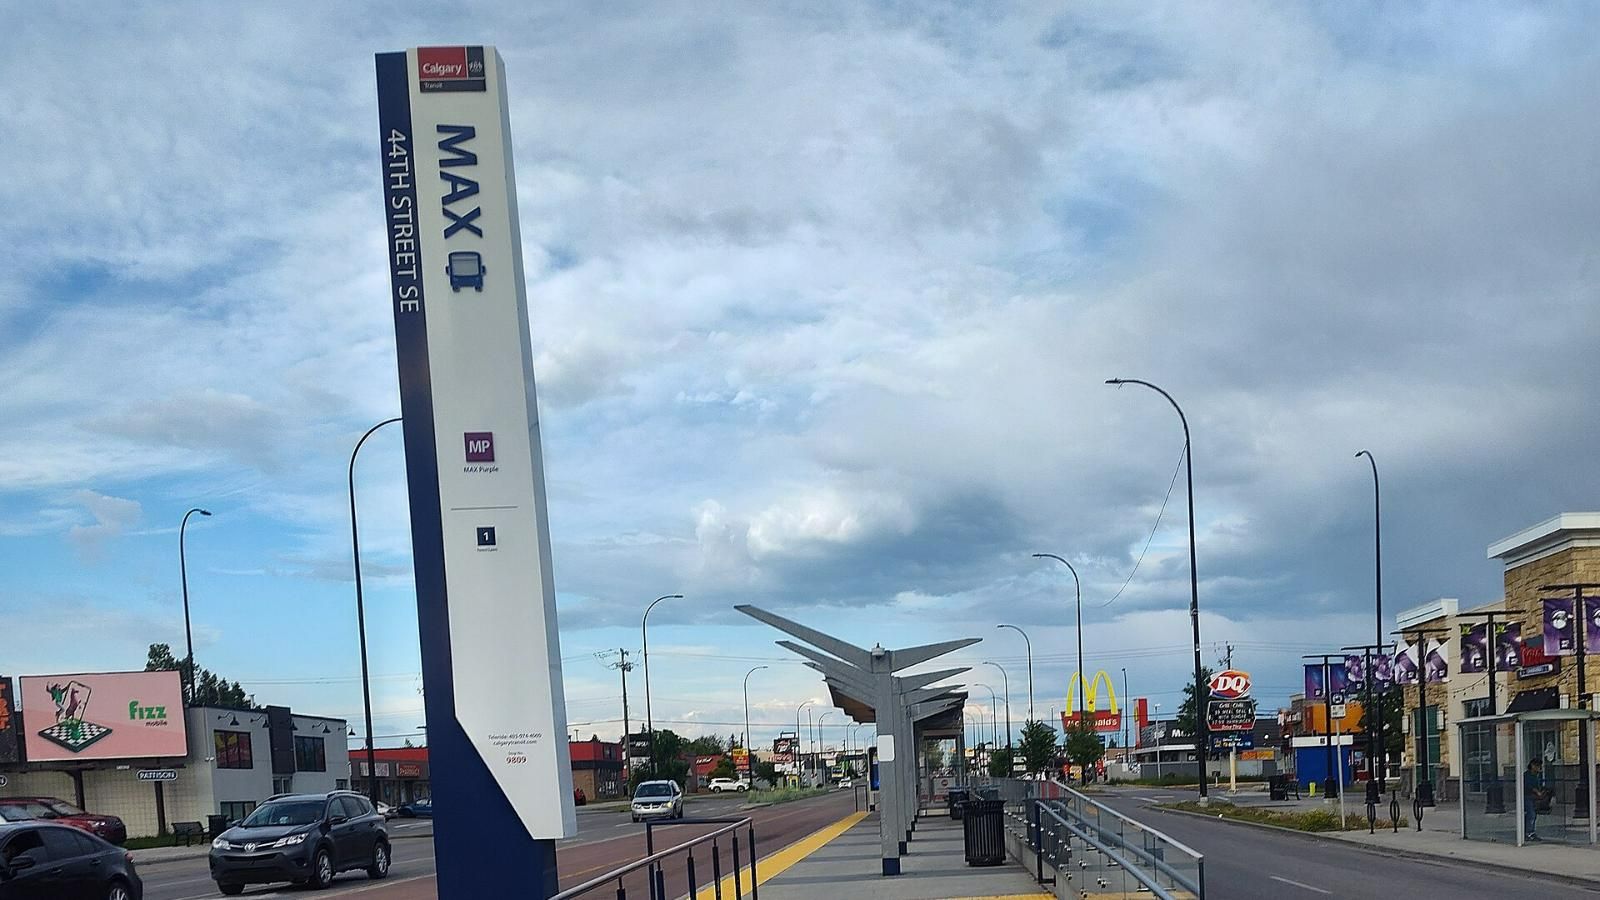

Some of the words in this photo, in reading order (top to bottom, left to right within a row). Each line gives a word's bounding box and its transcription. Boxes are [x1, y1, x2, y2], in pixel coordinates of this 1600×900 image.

[422, 62, 462, 76] Calgary
[387, 128, 411, 189] 44TH
[436, 124, 483, 240] MAX
[391, 196, 417, 280] STREET
[398, 286, 420, 313] SE
[469, 440, 491, 454] MP
[483, 531, 489, 541] 1
[1216, 676, 1246, 693] DQ
[128, 700, 167, 720] fizz
[506, 756, 527, 764] 9809
